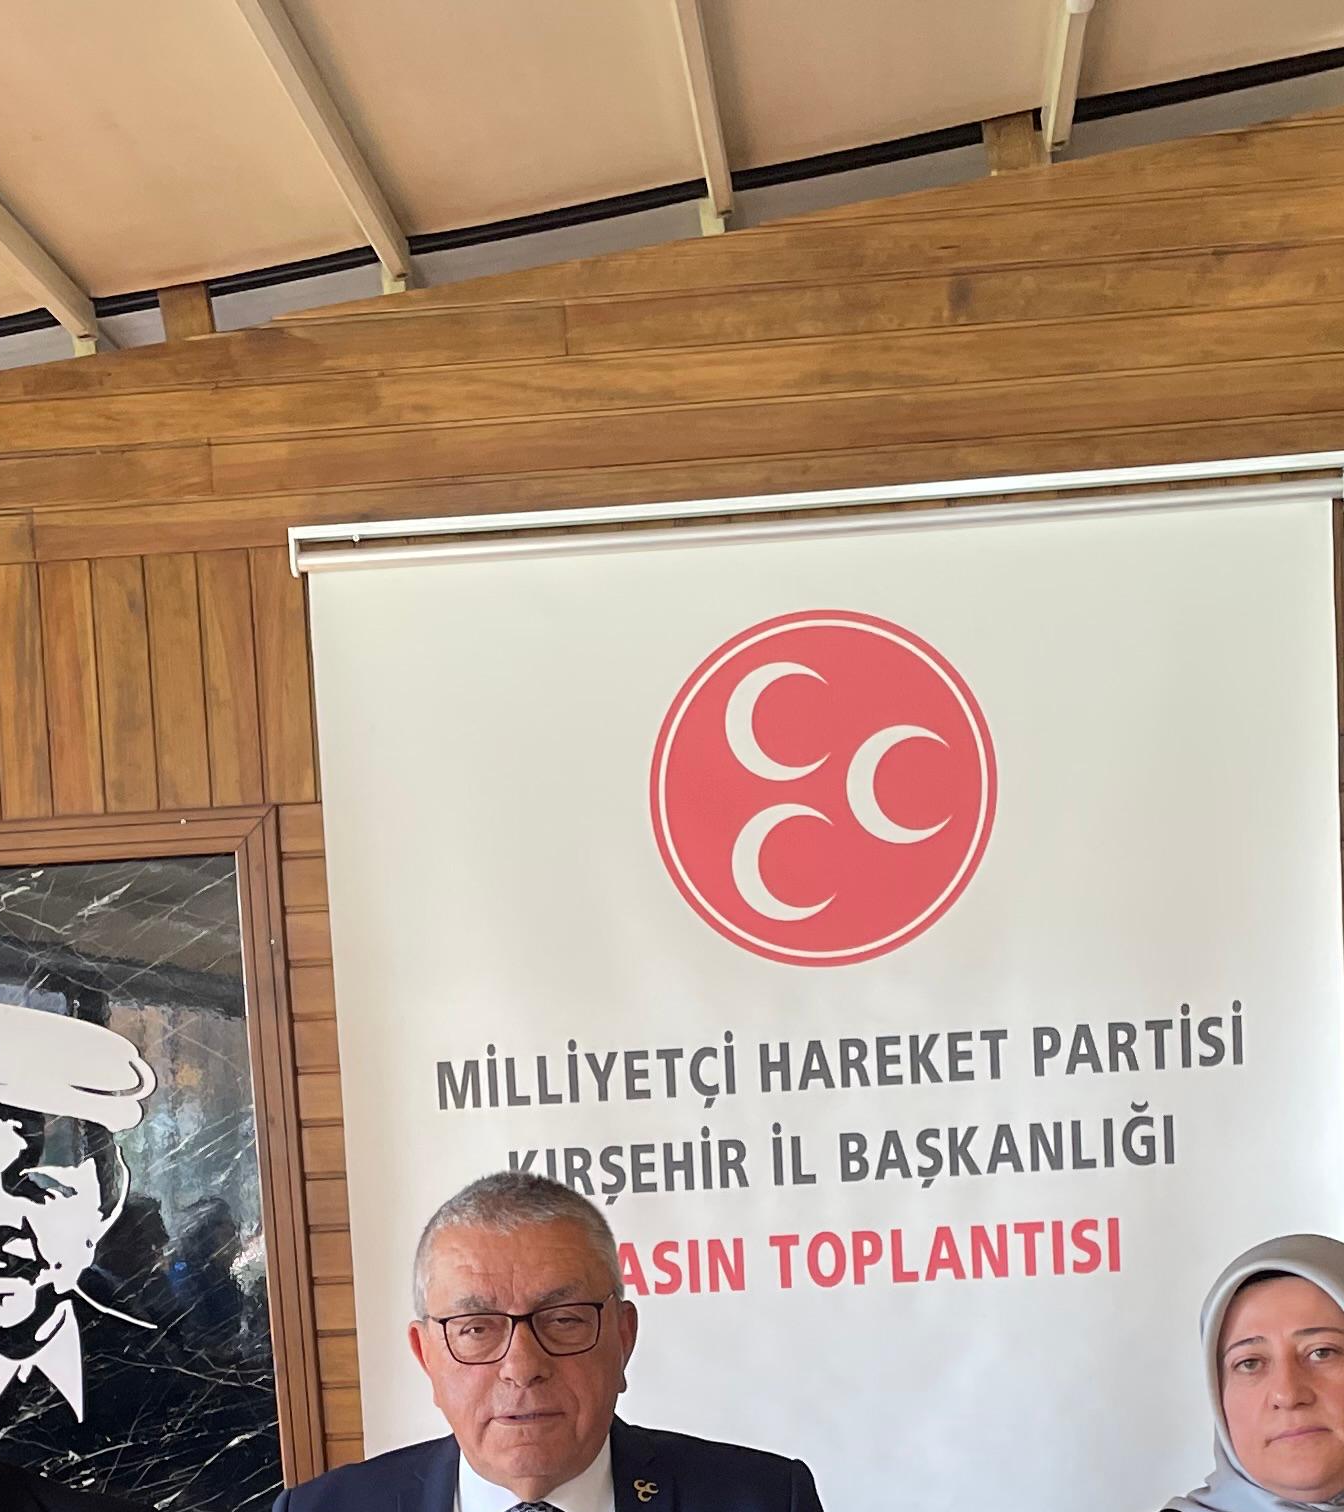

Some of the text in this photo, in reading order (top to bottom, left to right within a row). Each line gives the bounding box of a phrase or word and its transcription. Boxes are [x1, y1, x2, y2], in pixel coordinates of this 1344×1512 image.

[436, 999, 1243, 1110] MİLLİYETÇİ HAREKET PARTİSİ
[772, 1122, 817, 1186] İL
[839, 1100, 1175, 1189] BAŞKANLIĞI
[617, 1217, 1121, 1296] ASIN TOPLANTISI
